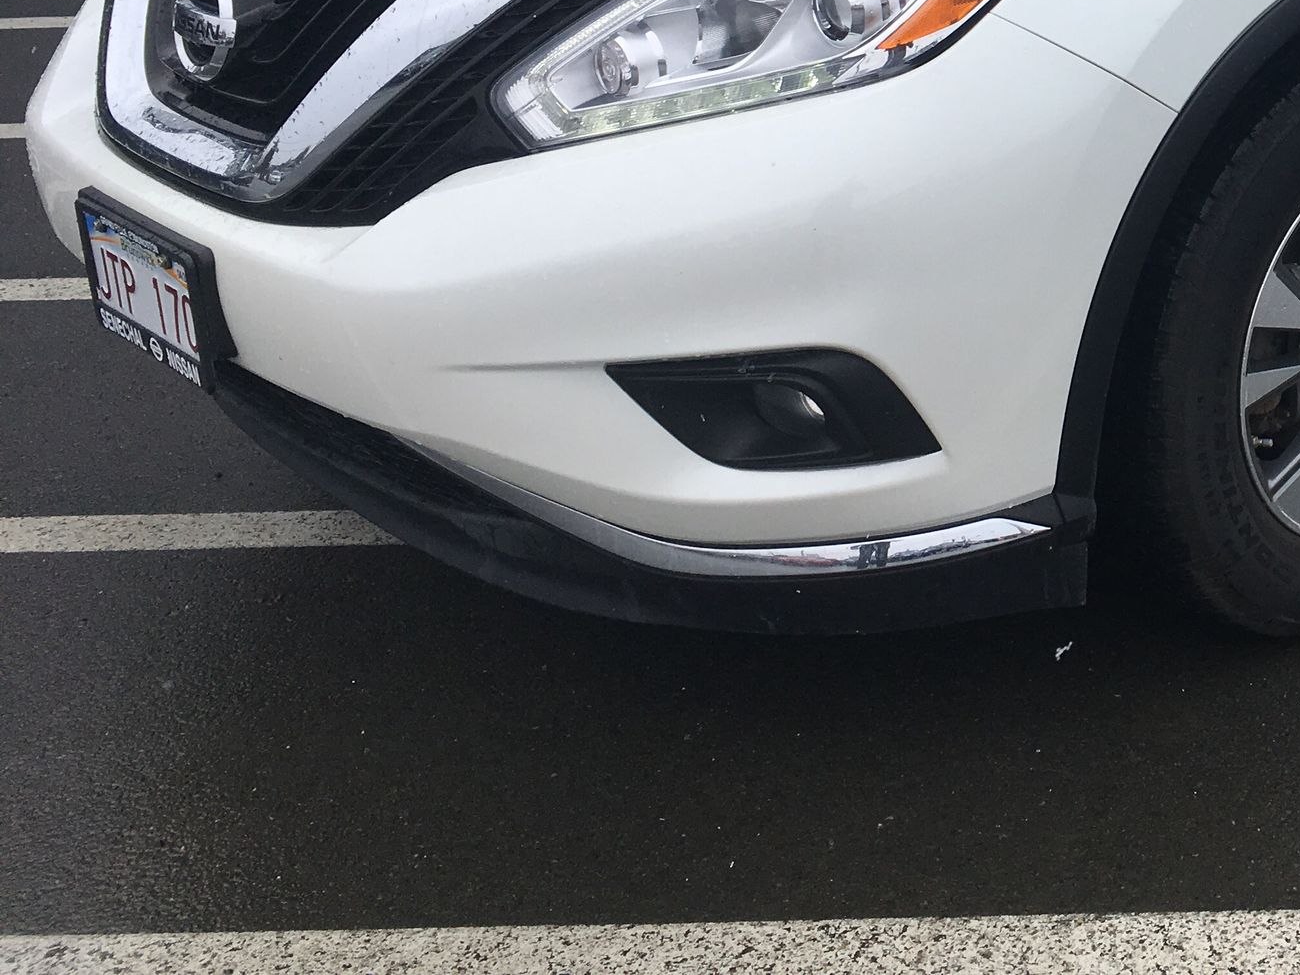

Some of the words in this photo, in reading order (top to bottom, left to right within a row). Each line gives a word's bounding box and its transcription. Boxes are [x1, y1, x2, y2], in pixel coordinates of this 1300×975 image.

[100, 246, 136, 315] JTP
[100, 308, 148, 352] SENECHAL
[165, 347, 202, 387] NISSAN
